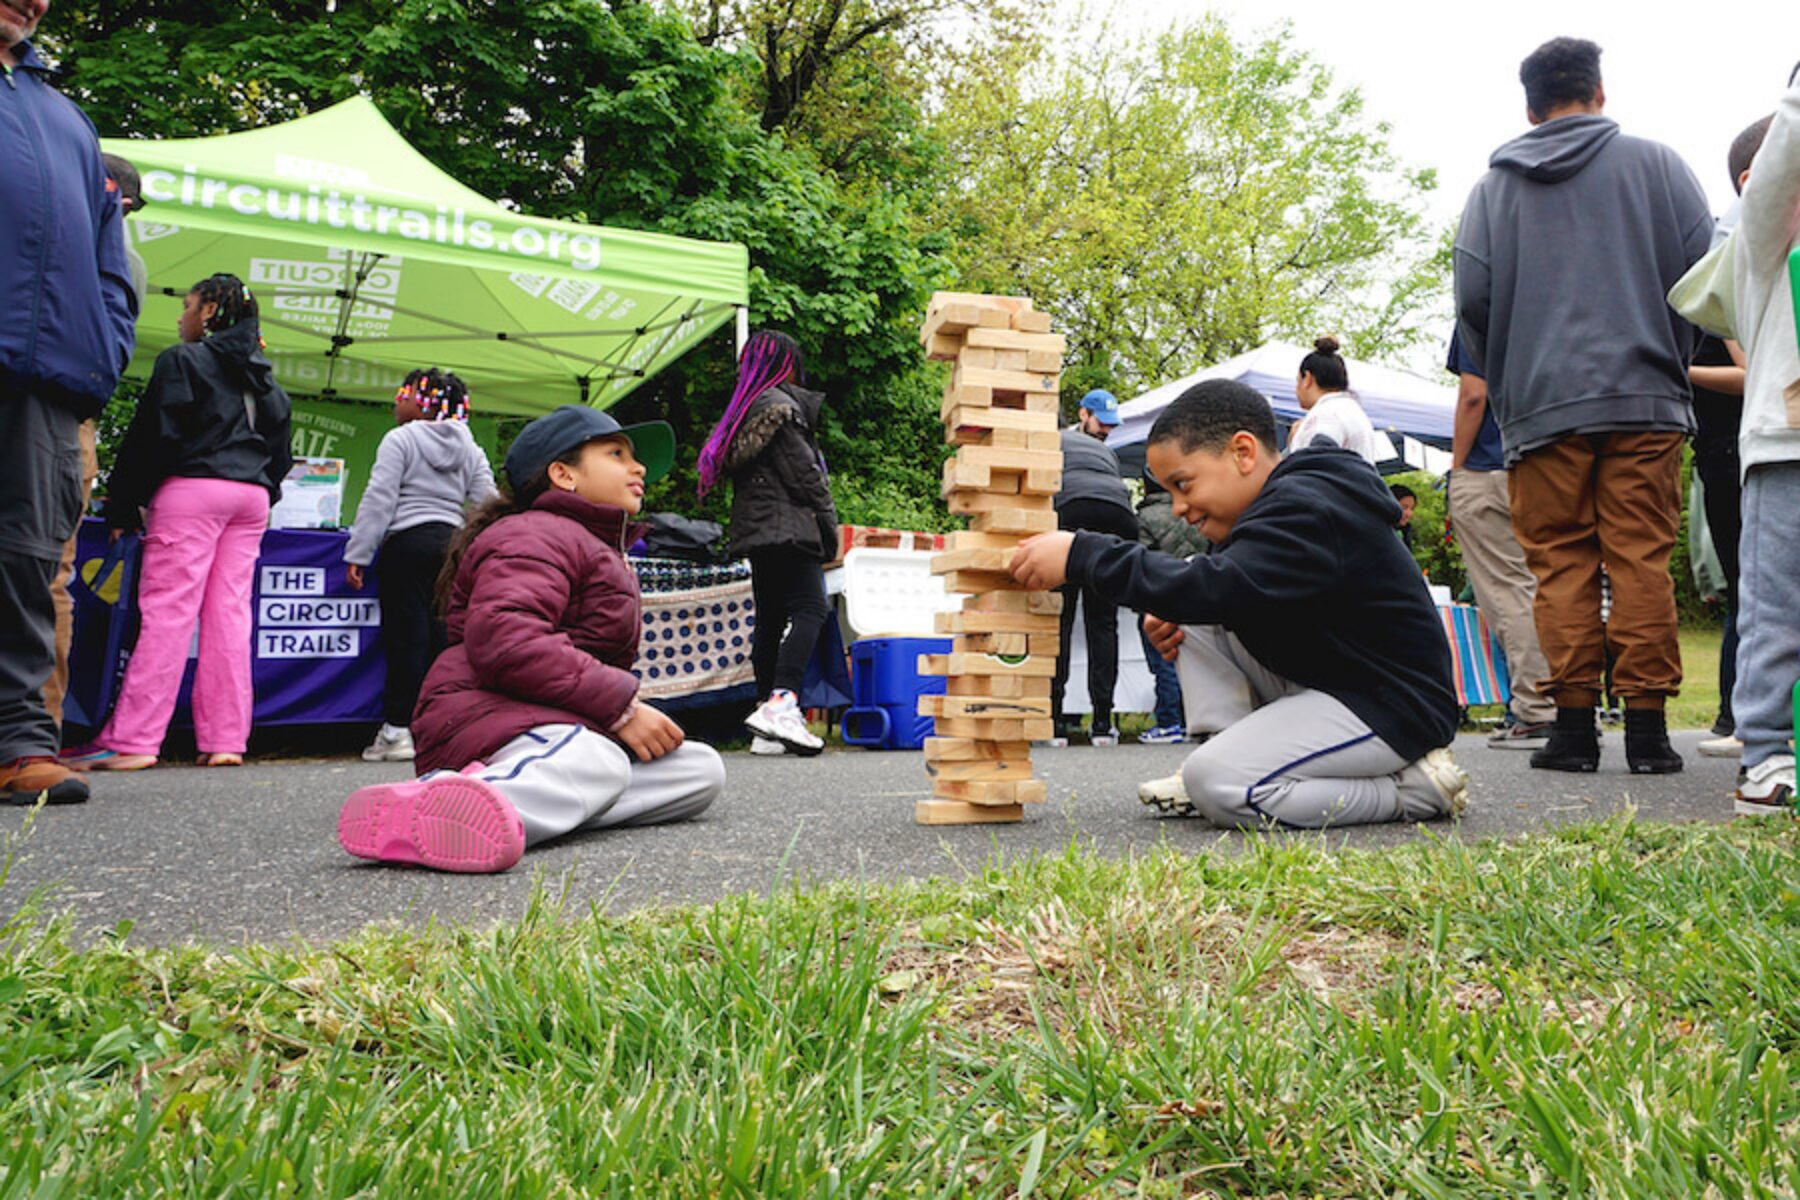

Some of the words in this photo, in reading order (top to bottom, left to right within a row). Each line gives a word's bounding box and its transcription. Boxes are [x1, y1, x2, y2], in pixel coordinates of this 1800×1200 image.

[141, 164, 601, 270] circuittrails.org
[291, 427, 340, 458] ATE
[268, 571, 316, 590] THE
[266, 603, 375, 621] CIRCUIT
[265, 634, 351, 653] TRAILS
